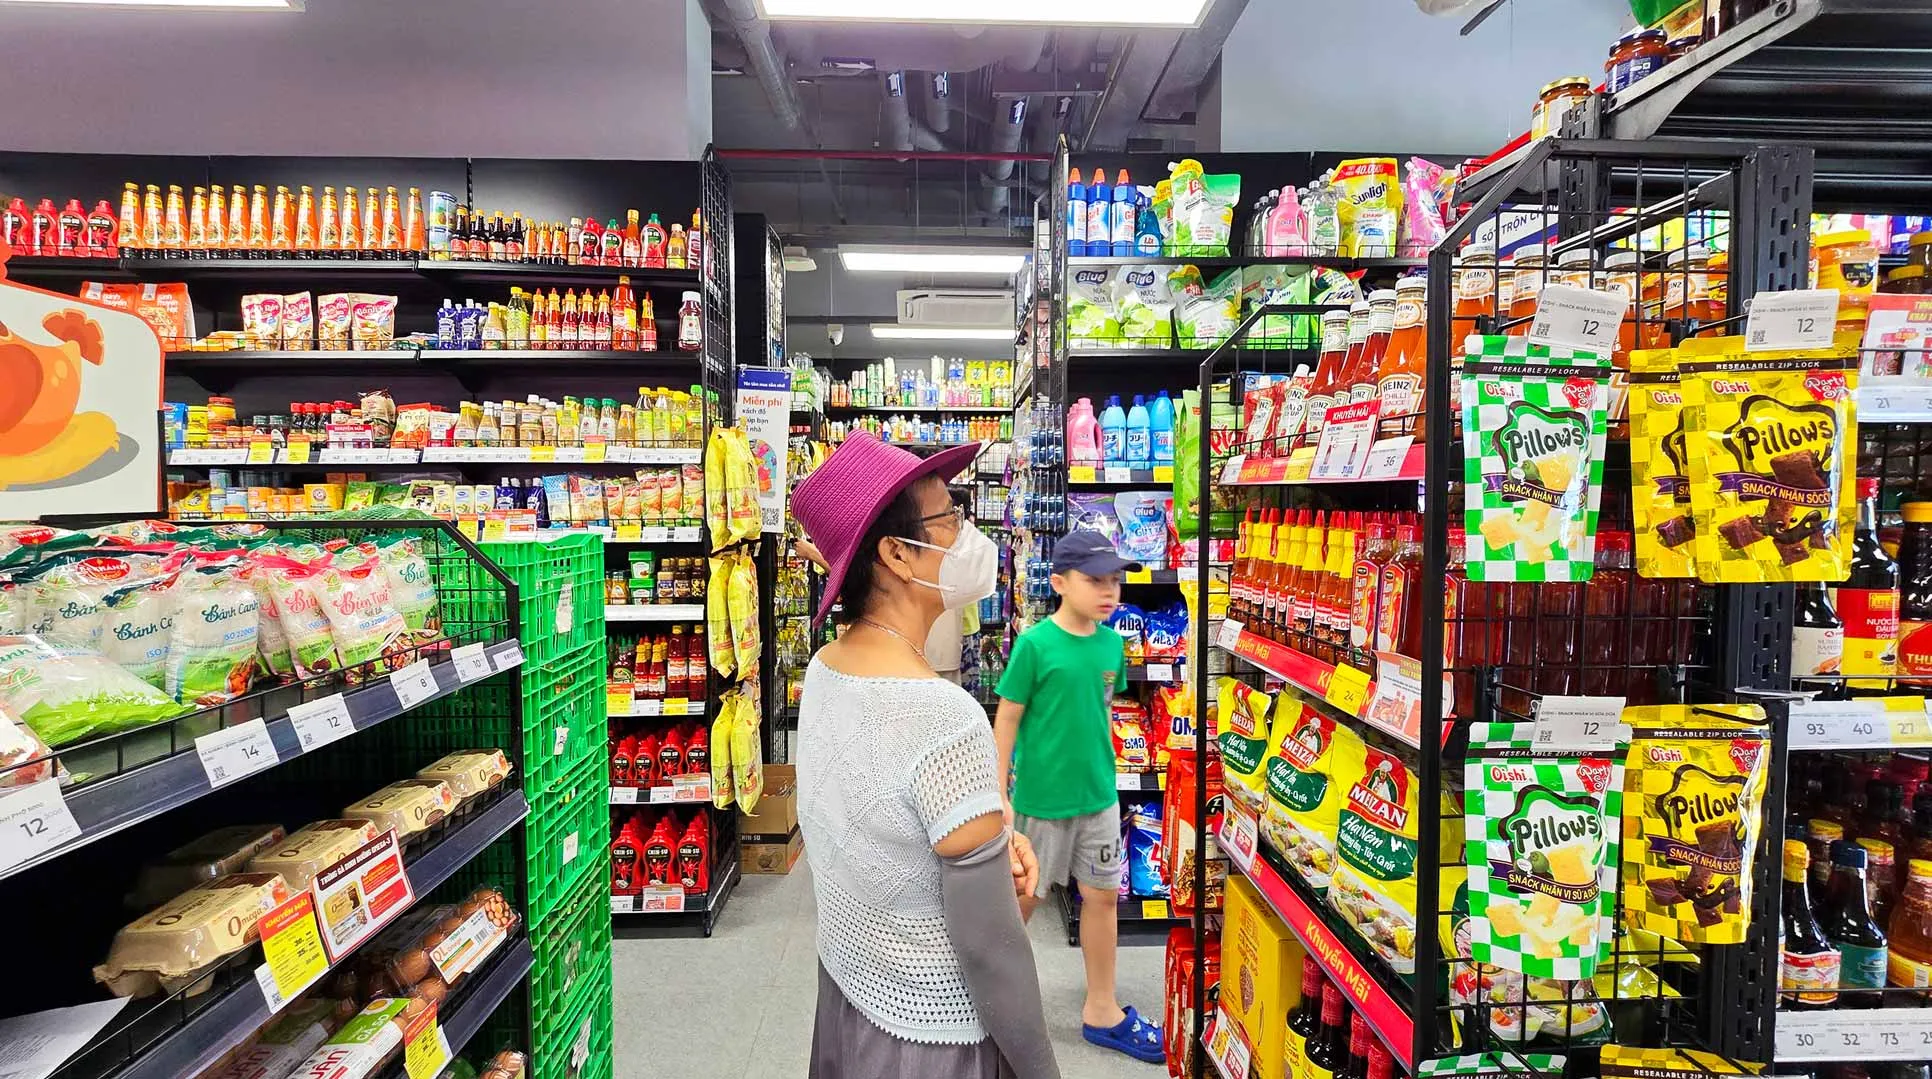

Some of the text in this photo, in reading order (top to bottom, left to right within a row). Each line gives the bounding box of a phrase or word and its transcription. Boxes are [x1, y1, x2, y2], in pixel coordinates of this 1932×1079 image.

[1351, 182, 1388, 205] Sunligh
[1501, 212, 1528, 235] TRỘN
[1582, 319, 1600, 336] 12
[1797, 318, 1815, 333] 12
[1543, 366, 1557, 375] ZIP
[1558, 367, 1580, 376] LOCK
[1716, 360, 1820, 371] RESEALABLE ZIP LOCK
[1383, 381, 1410, 393] HEINZ
[1713, 379, 1750, 395] Oishi
[1805, 375, 1845, 392] Party
[743, 395, 783, 408] Miễn phí
[1654, 391, 1682, 404] Oish
[1504, 426, 1585, 462] Pillows
[1736, 420, 1834, 460] Pillows
[1383, 455, 1396, 467] 36
[1503, 482, 1553, 503] SNACK NHÂN
[1742, 482, 1778, 498] SNACK
[1778, 488, 1805, 503] NHÂN
[59, 601, 98, 619] Bán
[201, 604, 238, 623] Bánh
[113, 622, 157, 641] Bánh
[1118, 616, 1143, 632] Aba
[420, 678, 428, 688] 8
[1344, 689, 1354, 702] 24
[327, 716, 341, 729] 12
[1172, 716, 1197, 736] OM
[1583, 722, 1600, 735] 12
[1806, 723, 1826, 735] 93
[1852, 723, 1873, 735] 40
[241, 744, 260, 760] 14
[1650, 747, 1683, 762] Oishi
[1490, 766, 1528, 783] Oishi
[1350, 783, 1407, 828] MEIZAN
[1667, 792, 1742, 828] Pillow
[20, 817, 48, 838] 12
[1342, 815, 1384, 849] Hạt Nêm
[1510, 814, 1599, 853] Pillows
[1669, 847, 1722, 871] SNACK NHÂN
[1508, 872, 1539, 892] SNACK
[1539, 881, 1562, 898] NHÂN
[1563, 887, 1572, 901] VỊ
[227, 906, 263, 937] Omega
[1305, 923, 1370, 1003] Khuyến Mãi
[1795, 1033, 1814, 1046] 30
[1841, 1033, 1861, 1046] 32
[1880, 1032, 1899, 1045] 73
[1633, 1069, 1687, 1079] RESEALABLE
